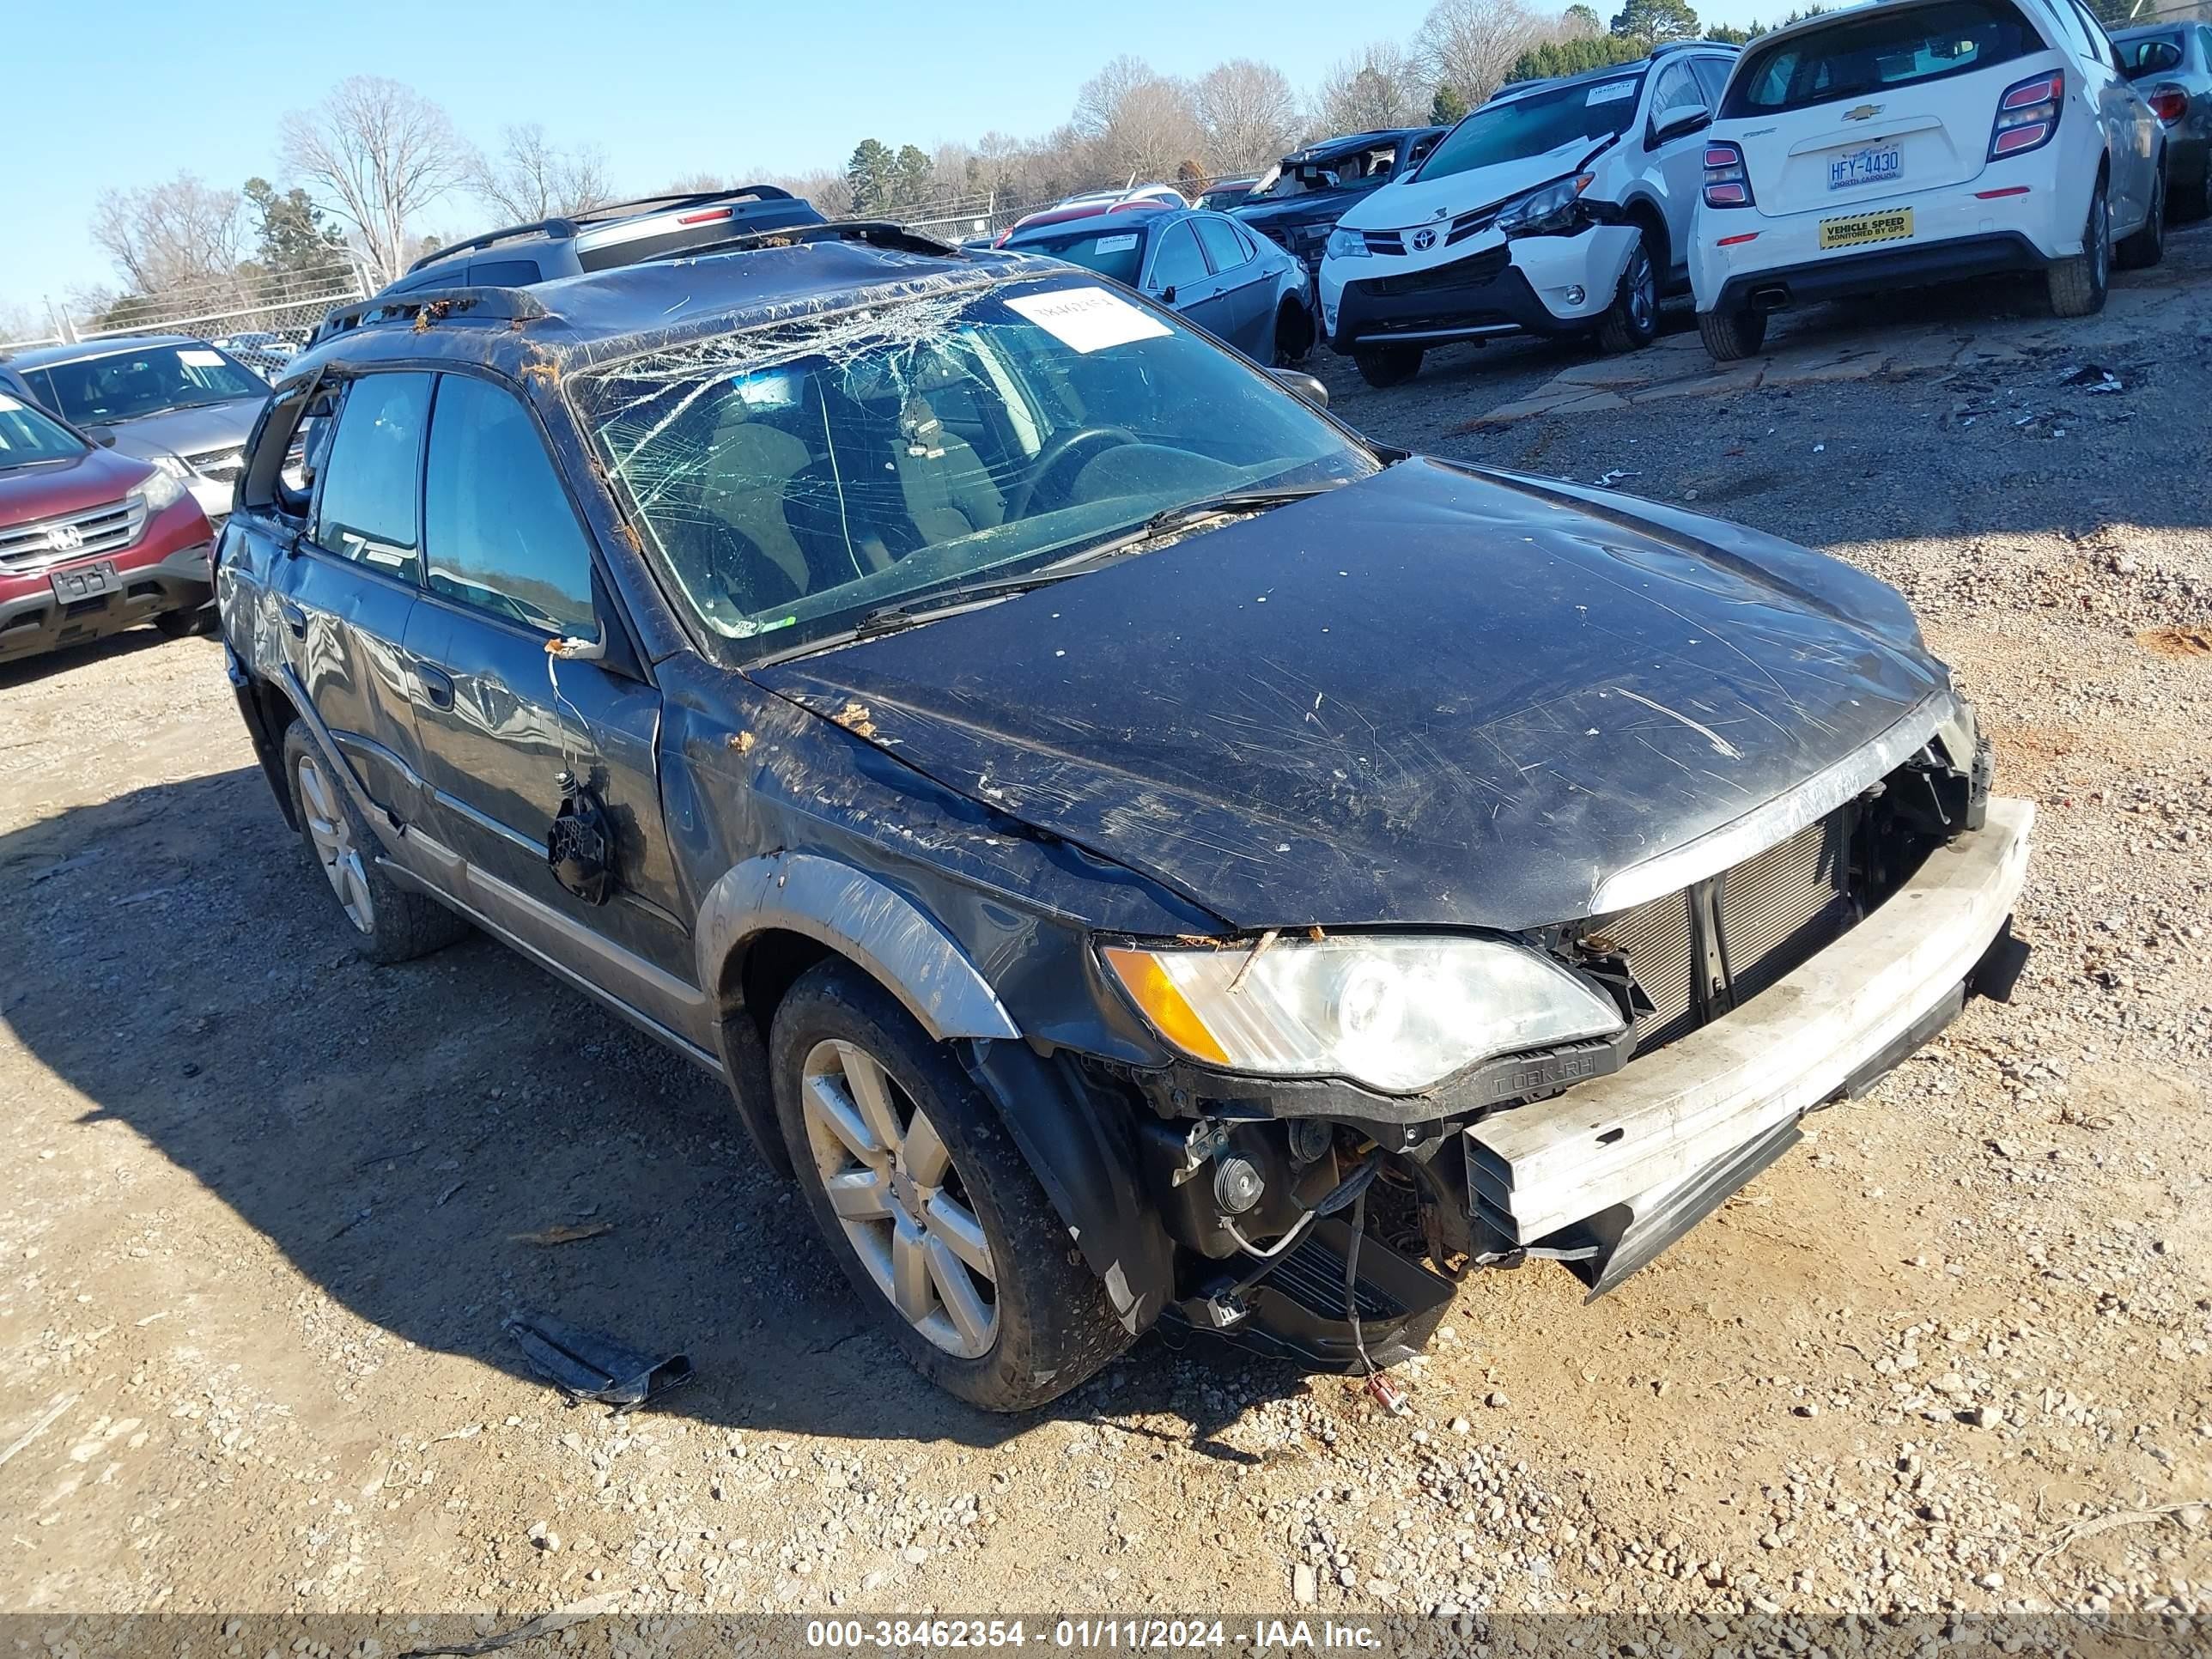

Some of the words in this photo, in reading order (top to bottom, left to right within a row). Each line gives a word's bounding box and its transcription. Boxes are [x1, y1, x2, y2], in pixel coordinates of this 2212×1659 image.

[1832, 151, 1899, 181] HFY-4430
[1861, 172, 1896, 183] CAROLINA
[1827, 222, 1868, 235] VEHICLE
[1872, 217, 1905, 228] SPEED
[1827, 229, 1873, 241] MONITORED
